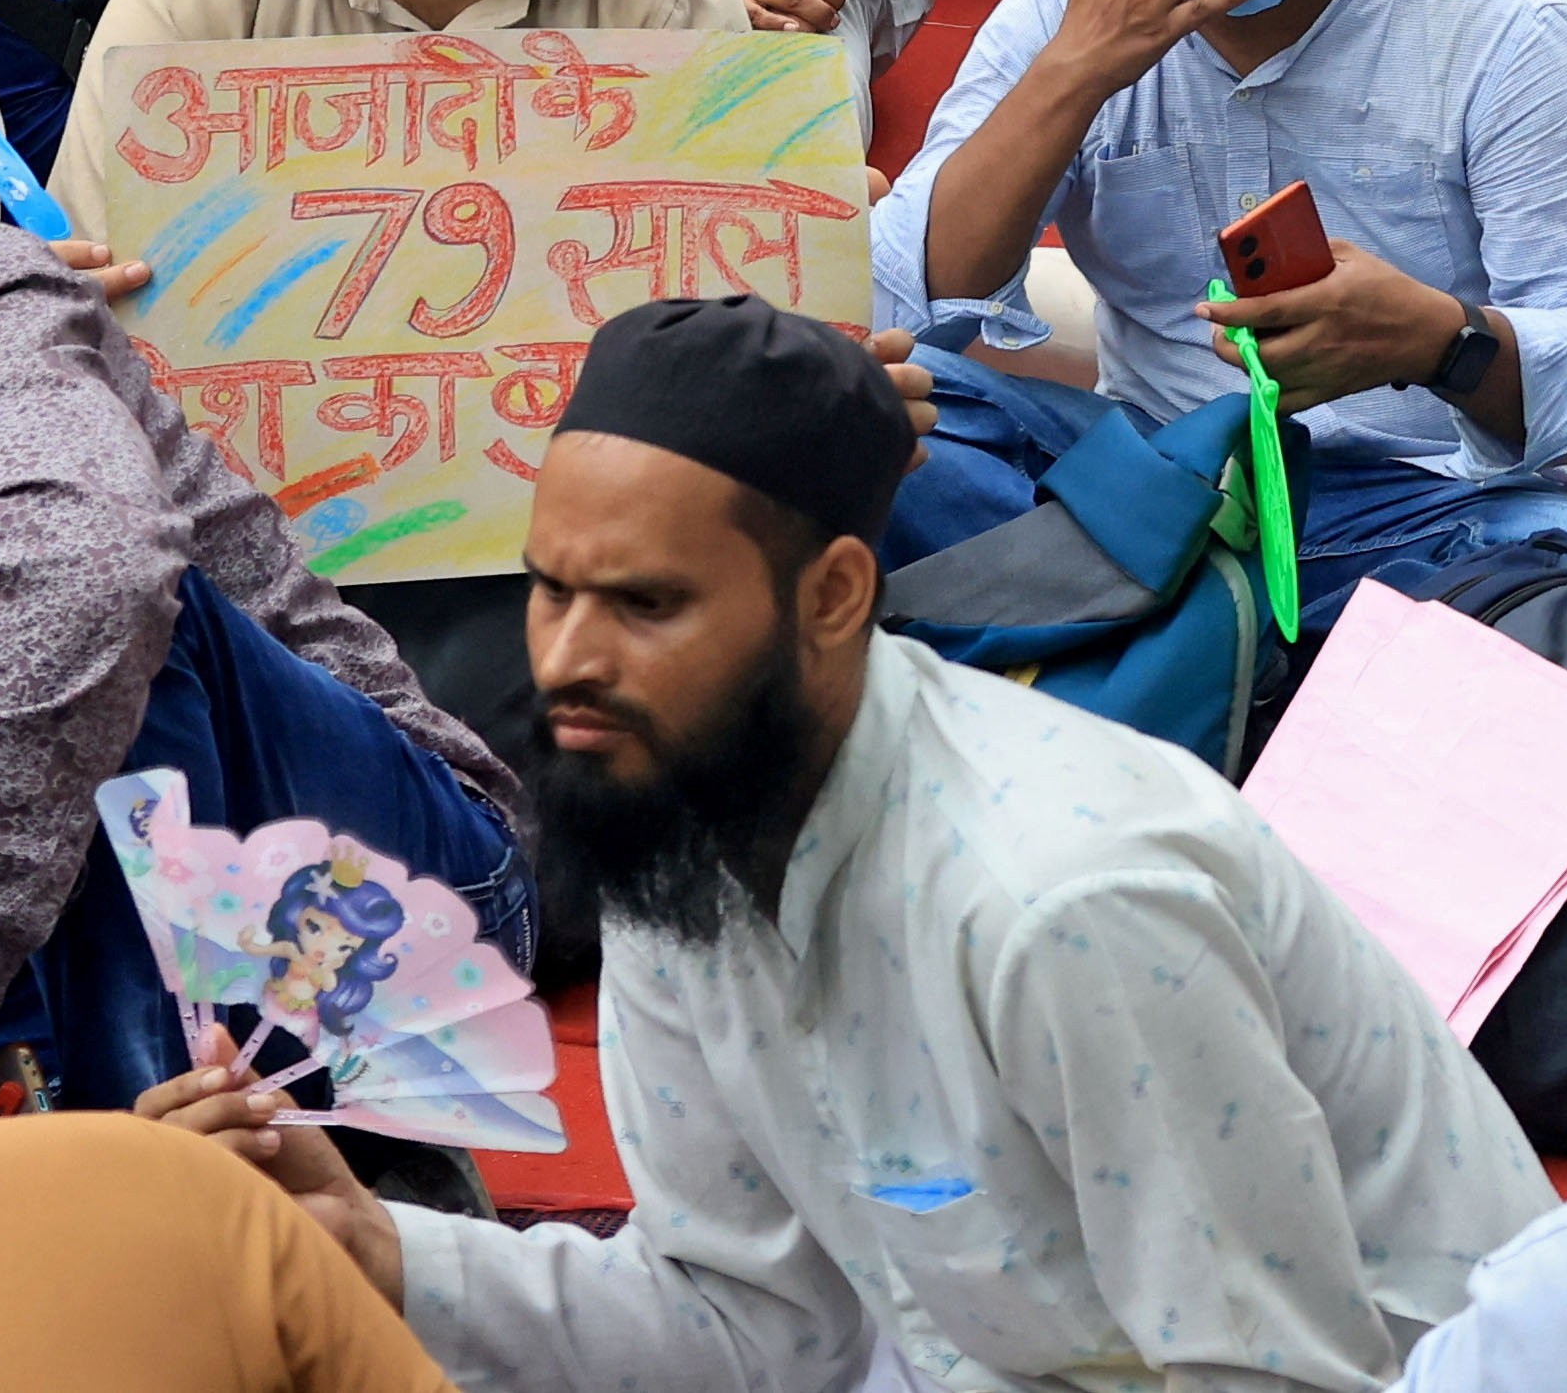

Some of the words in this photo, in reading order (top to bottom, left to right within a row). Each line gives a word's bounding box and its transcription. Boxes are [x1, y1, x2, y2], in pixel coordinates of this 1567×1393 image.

[290, 181, 518, 340] 79
[547, 176, 861, 327] साल
[316, 350, 493, 472] का
